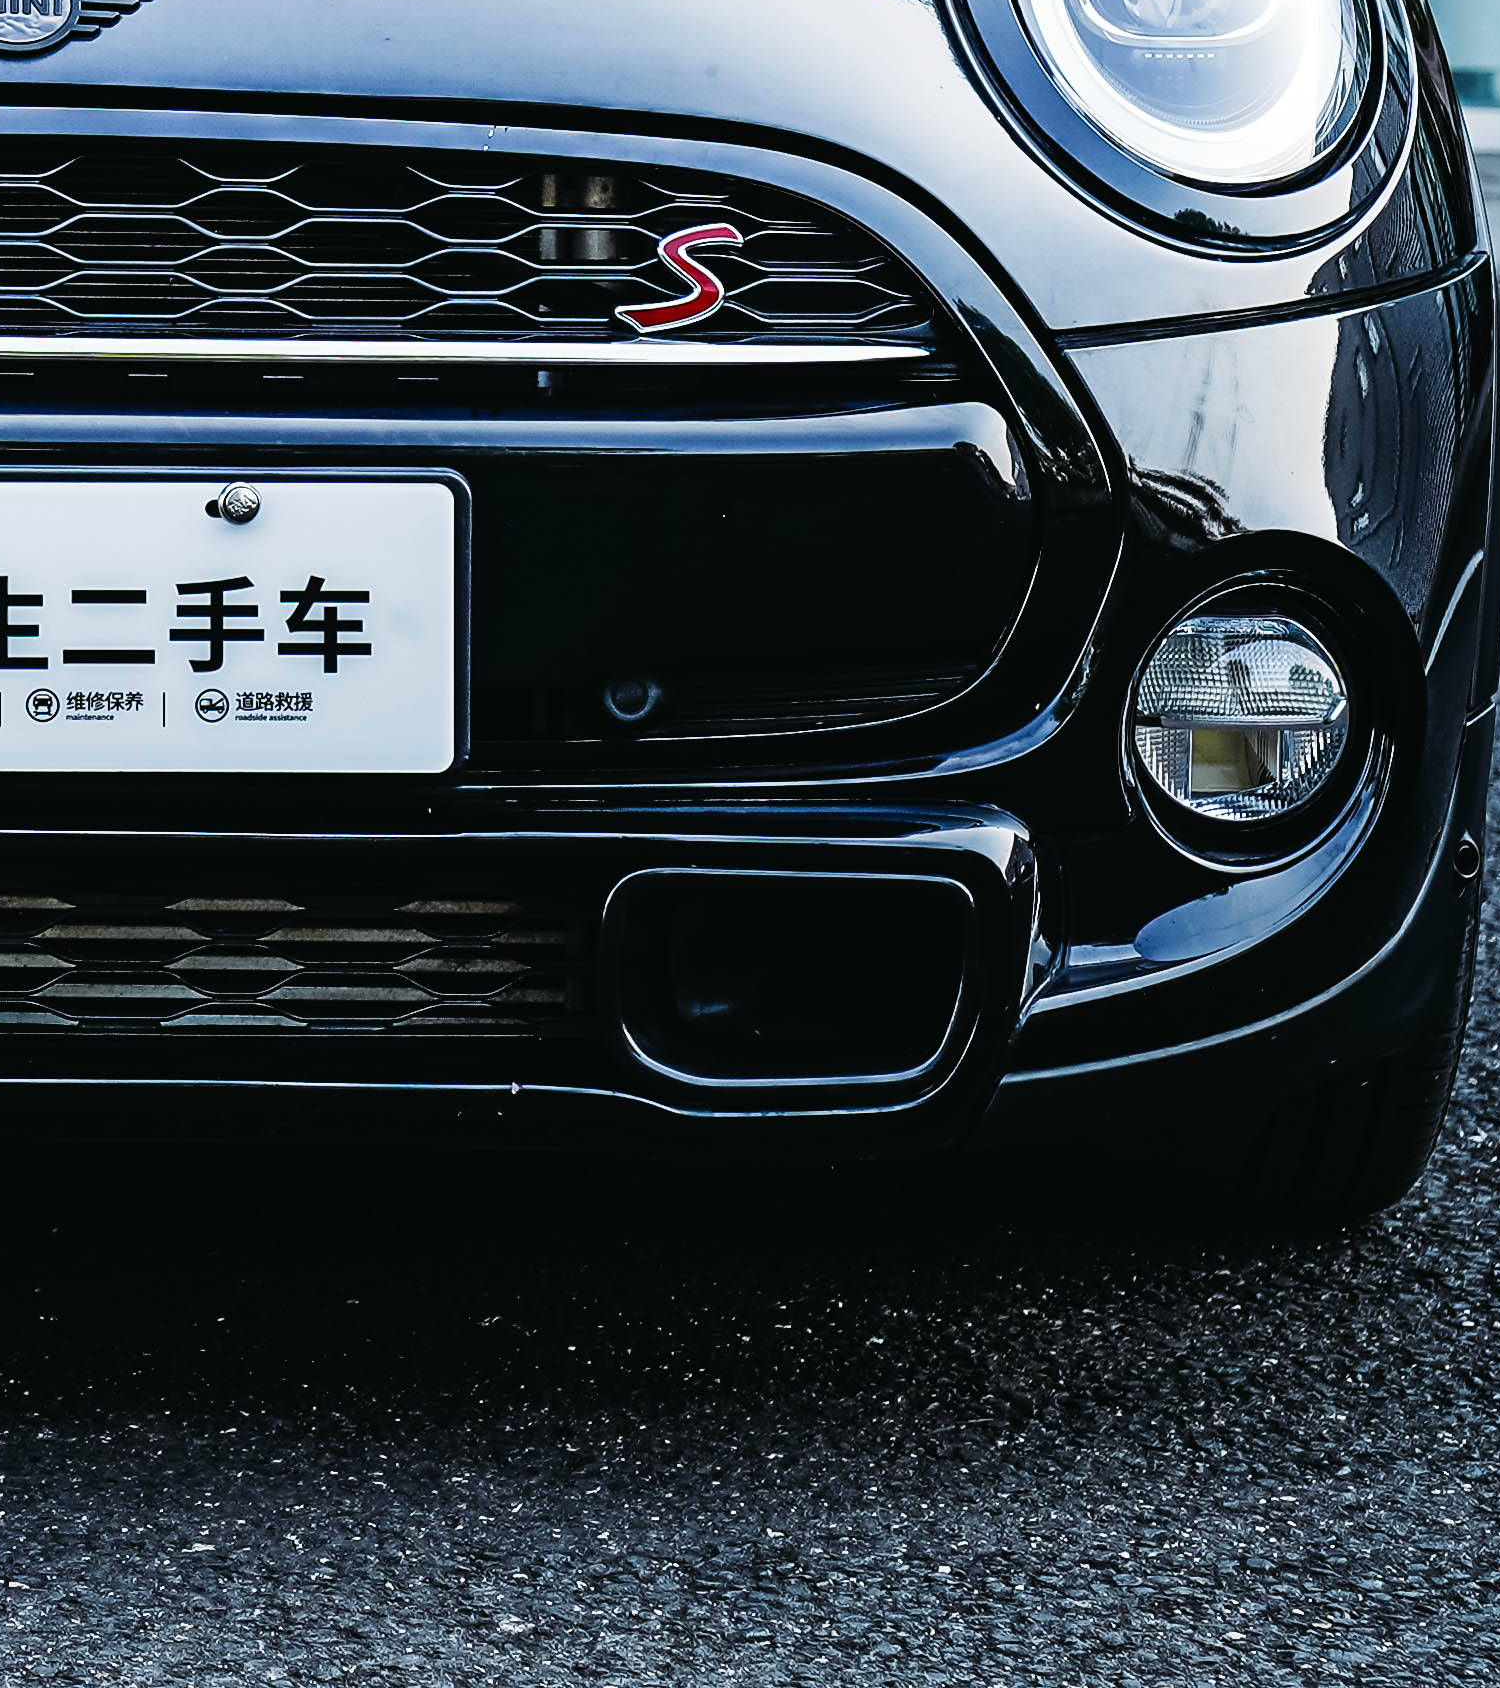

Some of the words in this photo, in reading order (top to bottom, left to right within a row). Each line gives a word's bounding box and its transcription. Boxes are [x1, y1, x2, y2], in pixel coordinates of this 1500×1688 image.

[614, 222, 744, 333] S
[66, 691, 144, 712] 维修保养
[235, 691, 314, 712] 道路救援
[65, 713, 115, 721] maintenance
[234, 713, 268, 721] roadside
